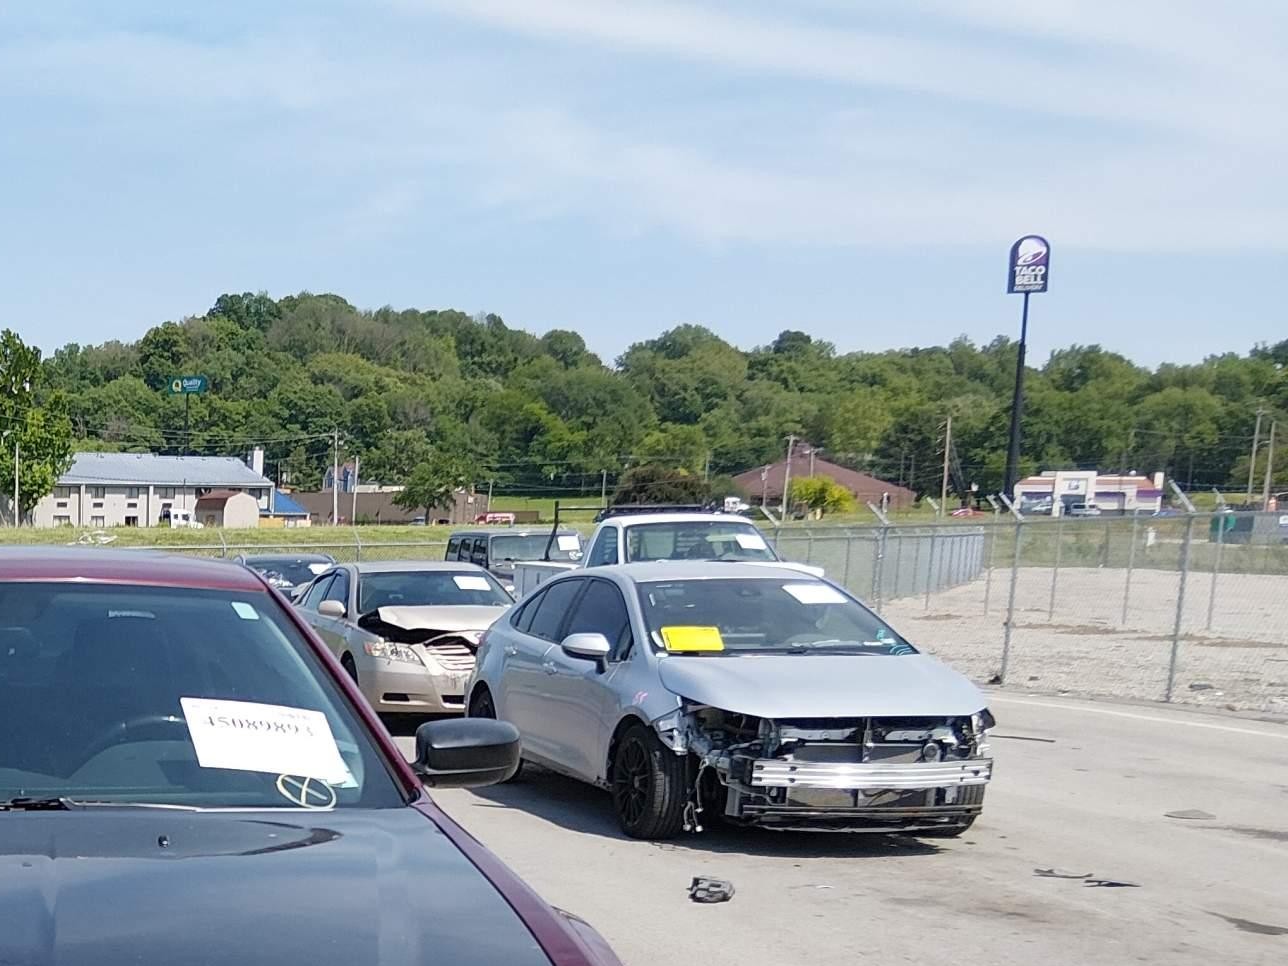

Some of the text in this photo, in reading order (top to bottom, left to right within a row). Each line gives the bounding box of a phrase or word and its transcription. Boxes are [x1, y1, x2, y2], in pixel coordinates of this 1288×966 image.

[1014, 265, 1046, 275] TACO
[1015, 274, 1045, 284] BELL
[183, 378, 202, 388] Quality
